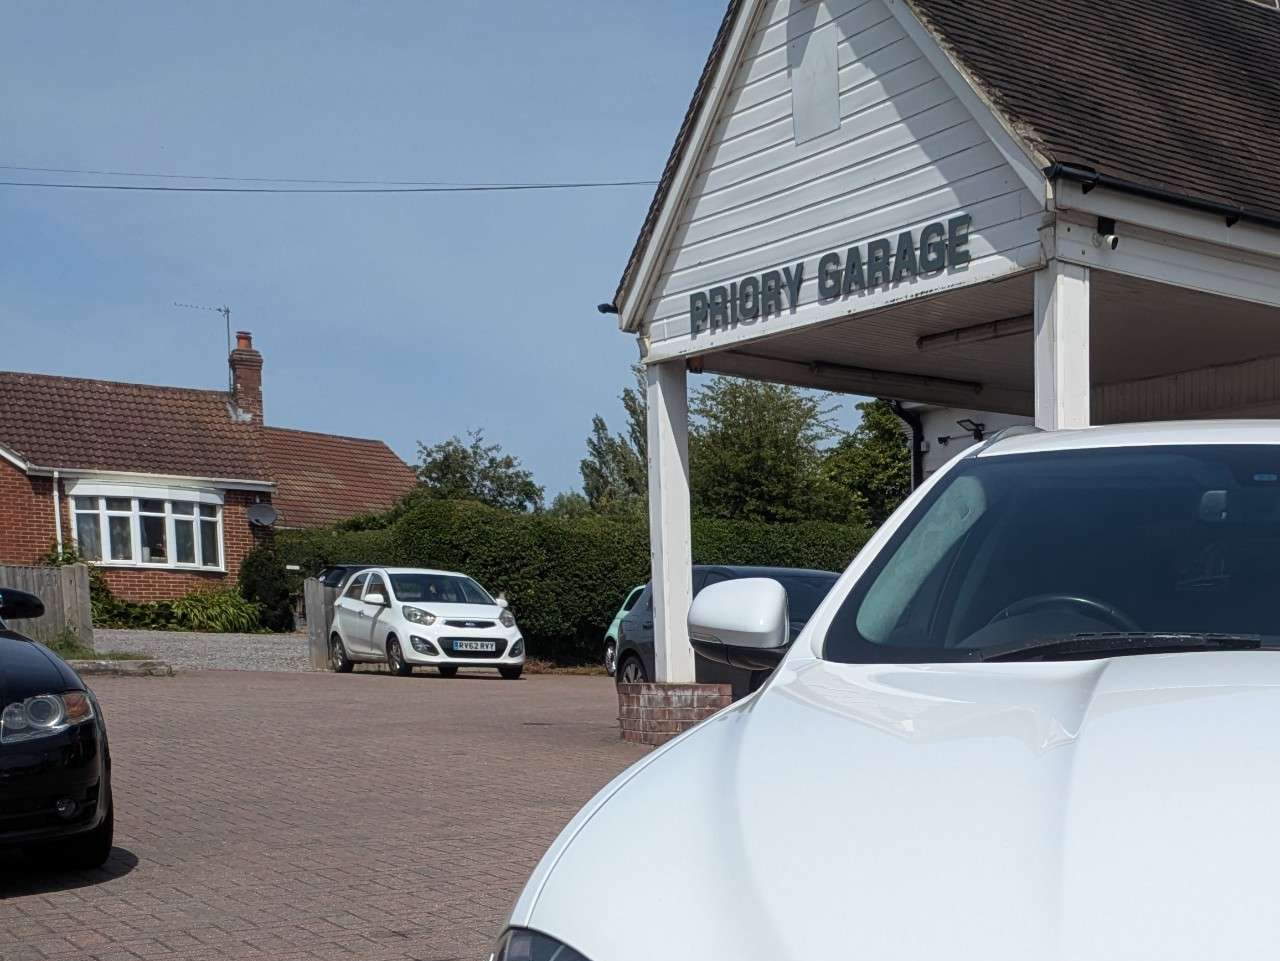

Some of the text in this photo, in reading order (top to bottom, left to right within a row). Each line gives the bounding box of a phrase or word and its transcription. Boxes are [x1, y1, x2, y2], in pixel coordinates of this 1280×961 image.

[690, 213, 972, 337] PRIORY GARAGE
[459, 642, 479, 650] RV62
